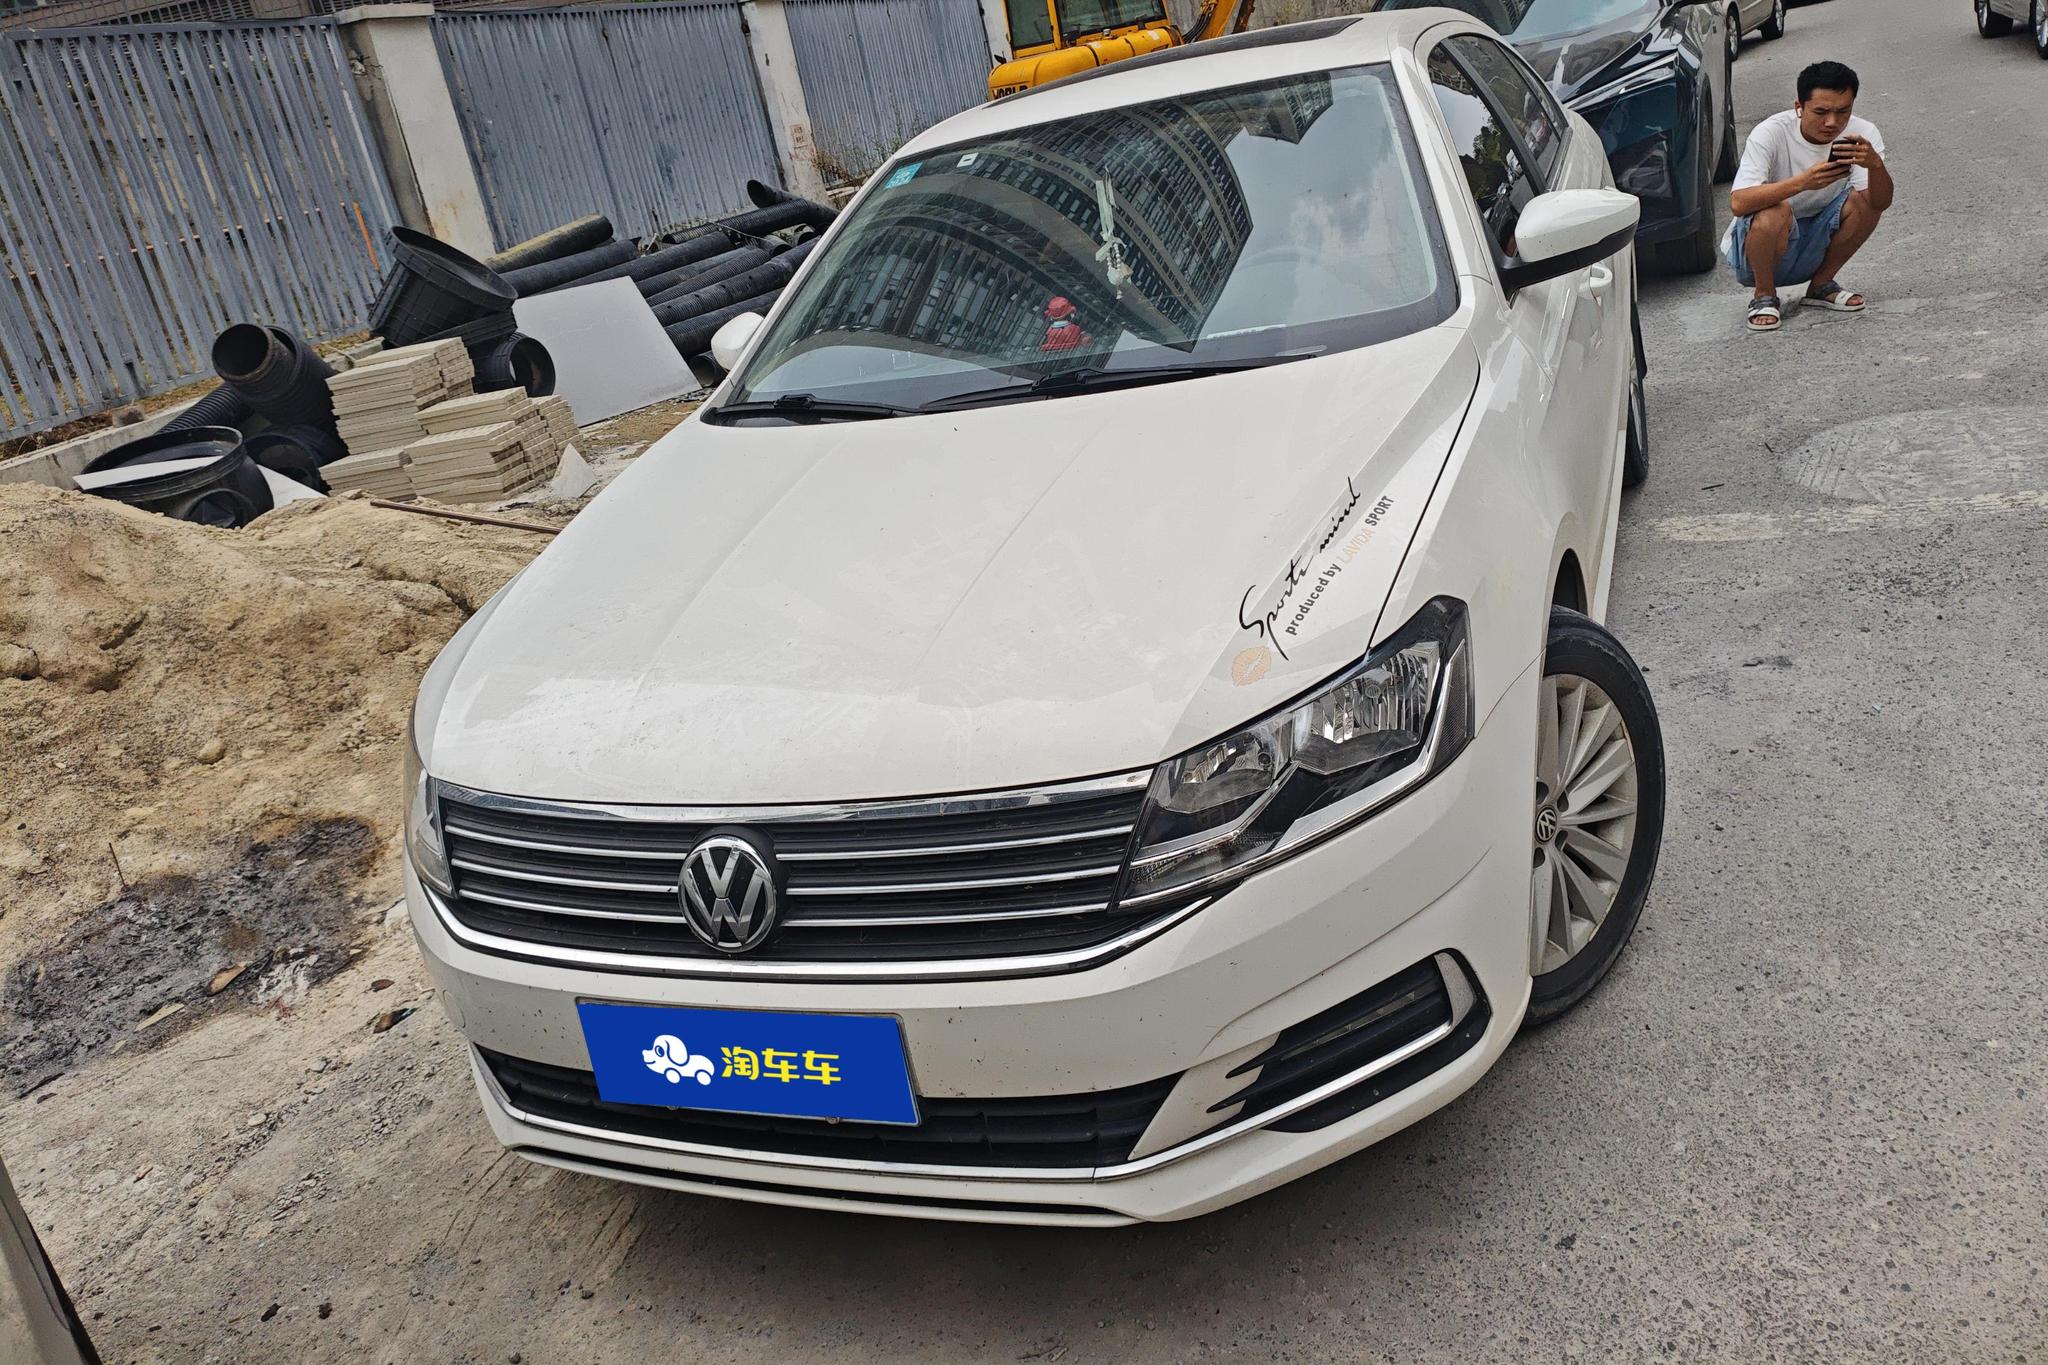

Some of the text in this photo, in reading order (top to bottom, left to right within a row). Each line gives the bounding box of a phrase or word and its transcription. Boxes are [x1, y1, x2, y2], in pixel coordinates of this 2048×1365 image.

[1285, 577, 1330, 636] produced
[1322, 563, 1342, 578] by
[1364, 495, 1395, 526] SPORT
